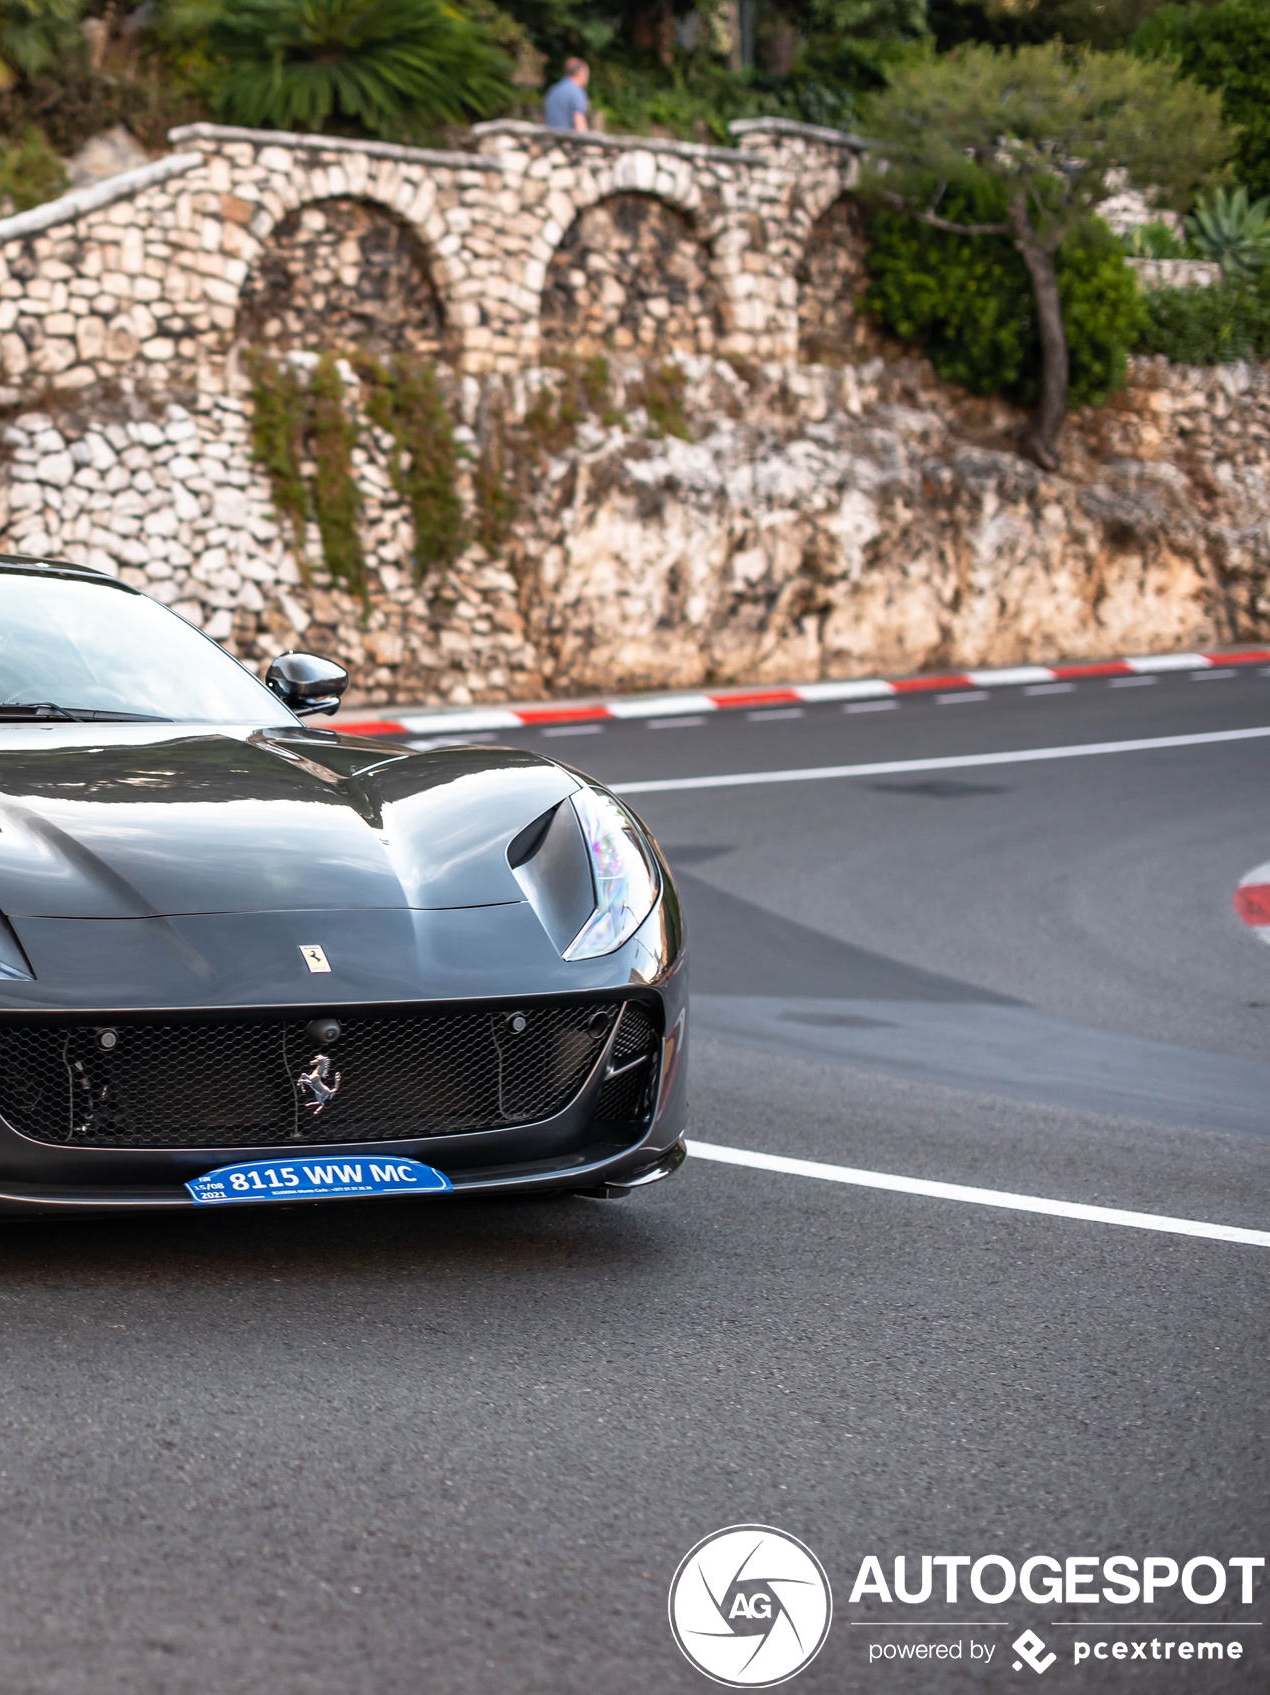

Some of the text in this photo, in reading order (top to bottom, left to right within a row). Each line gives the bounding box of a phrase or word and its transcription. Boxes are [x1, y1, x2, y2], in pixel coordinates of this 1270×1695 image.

[229, 1164, 417, 1191] 8115 WW MC
[200, 1191, 227, 1199] 2021
